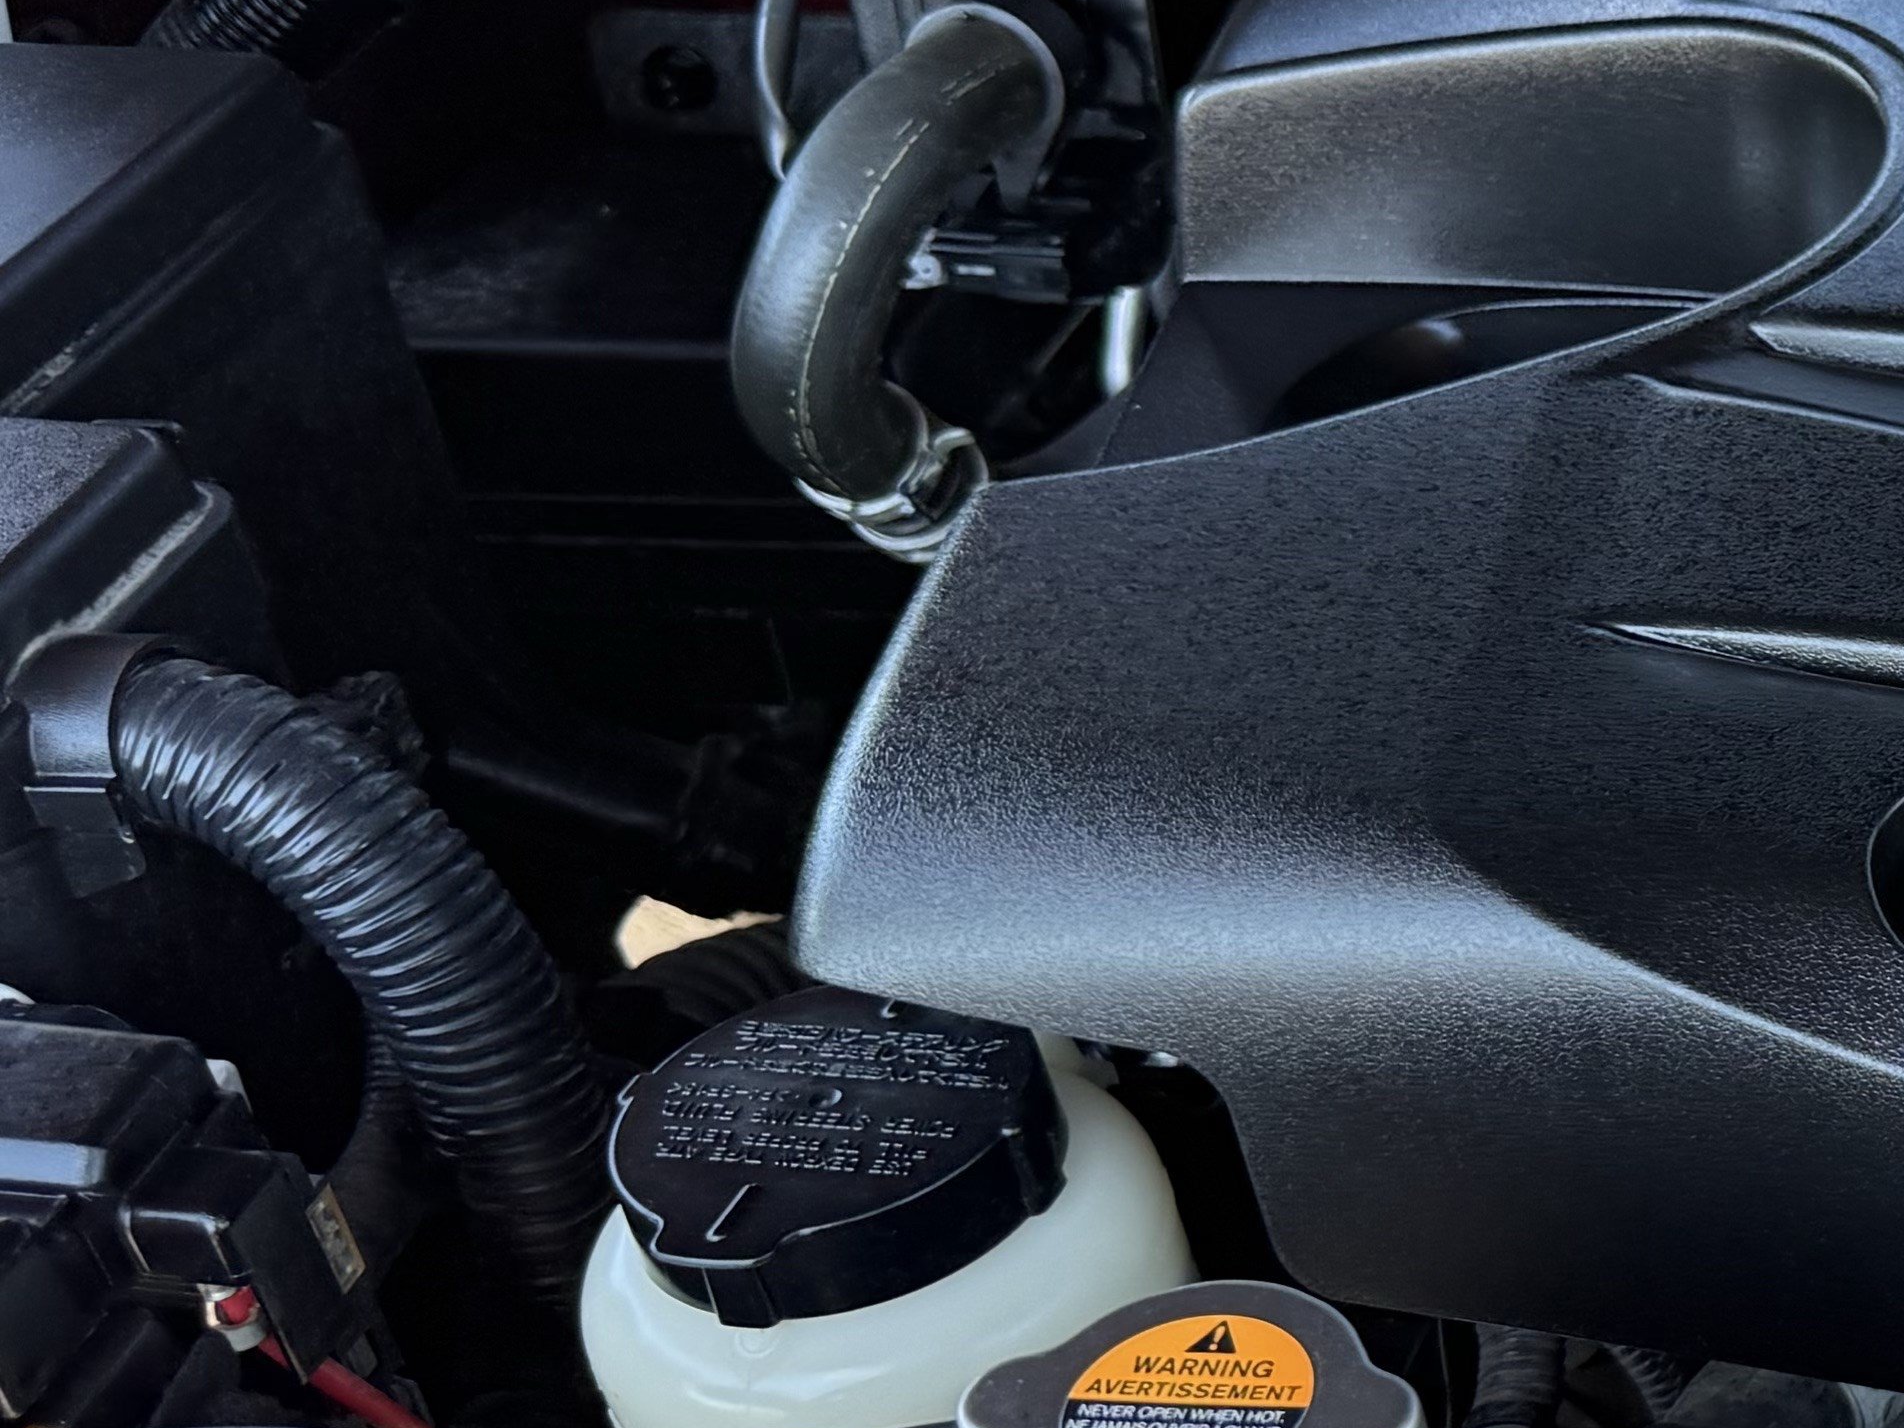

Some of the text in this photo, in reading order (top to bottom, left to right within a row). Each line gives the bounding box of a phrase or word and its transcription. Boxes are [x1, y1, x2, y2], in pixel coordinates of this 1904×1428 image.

[749, 1107, 871, 1132] STEERING
[742, 1133, 822, 1151] PROPER
[708, 1147, 763, 1166] TYPE
[1133, 1355, 1275, 1379] WARNING
[1084, 1379, 1303, 1402] AVERTISSEMENT
[1077, 1403, 1285, 1423] NEVER OPEN WHEN HOT.
